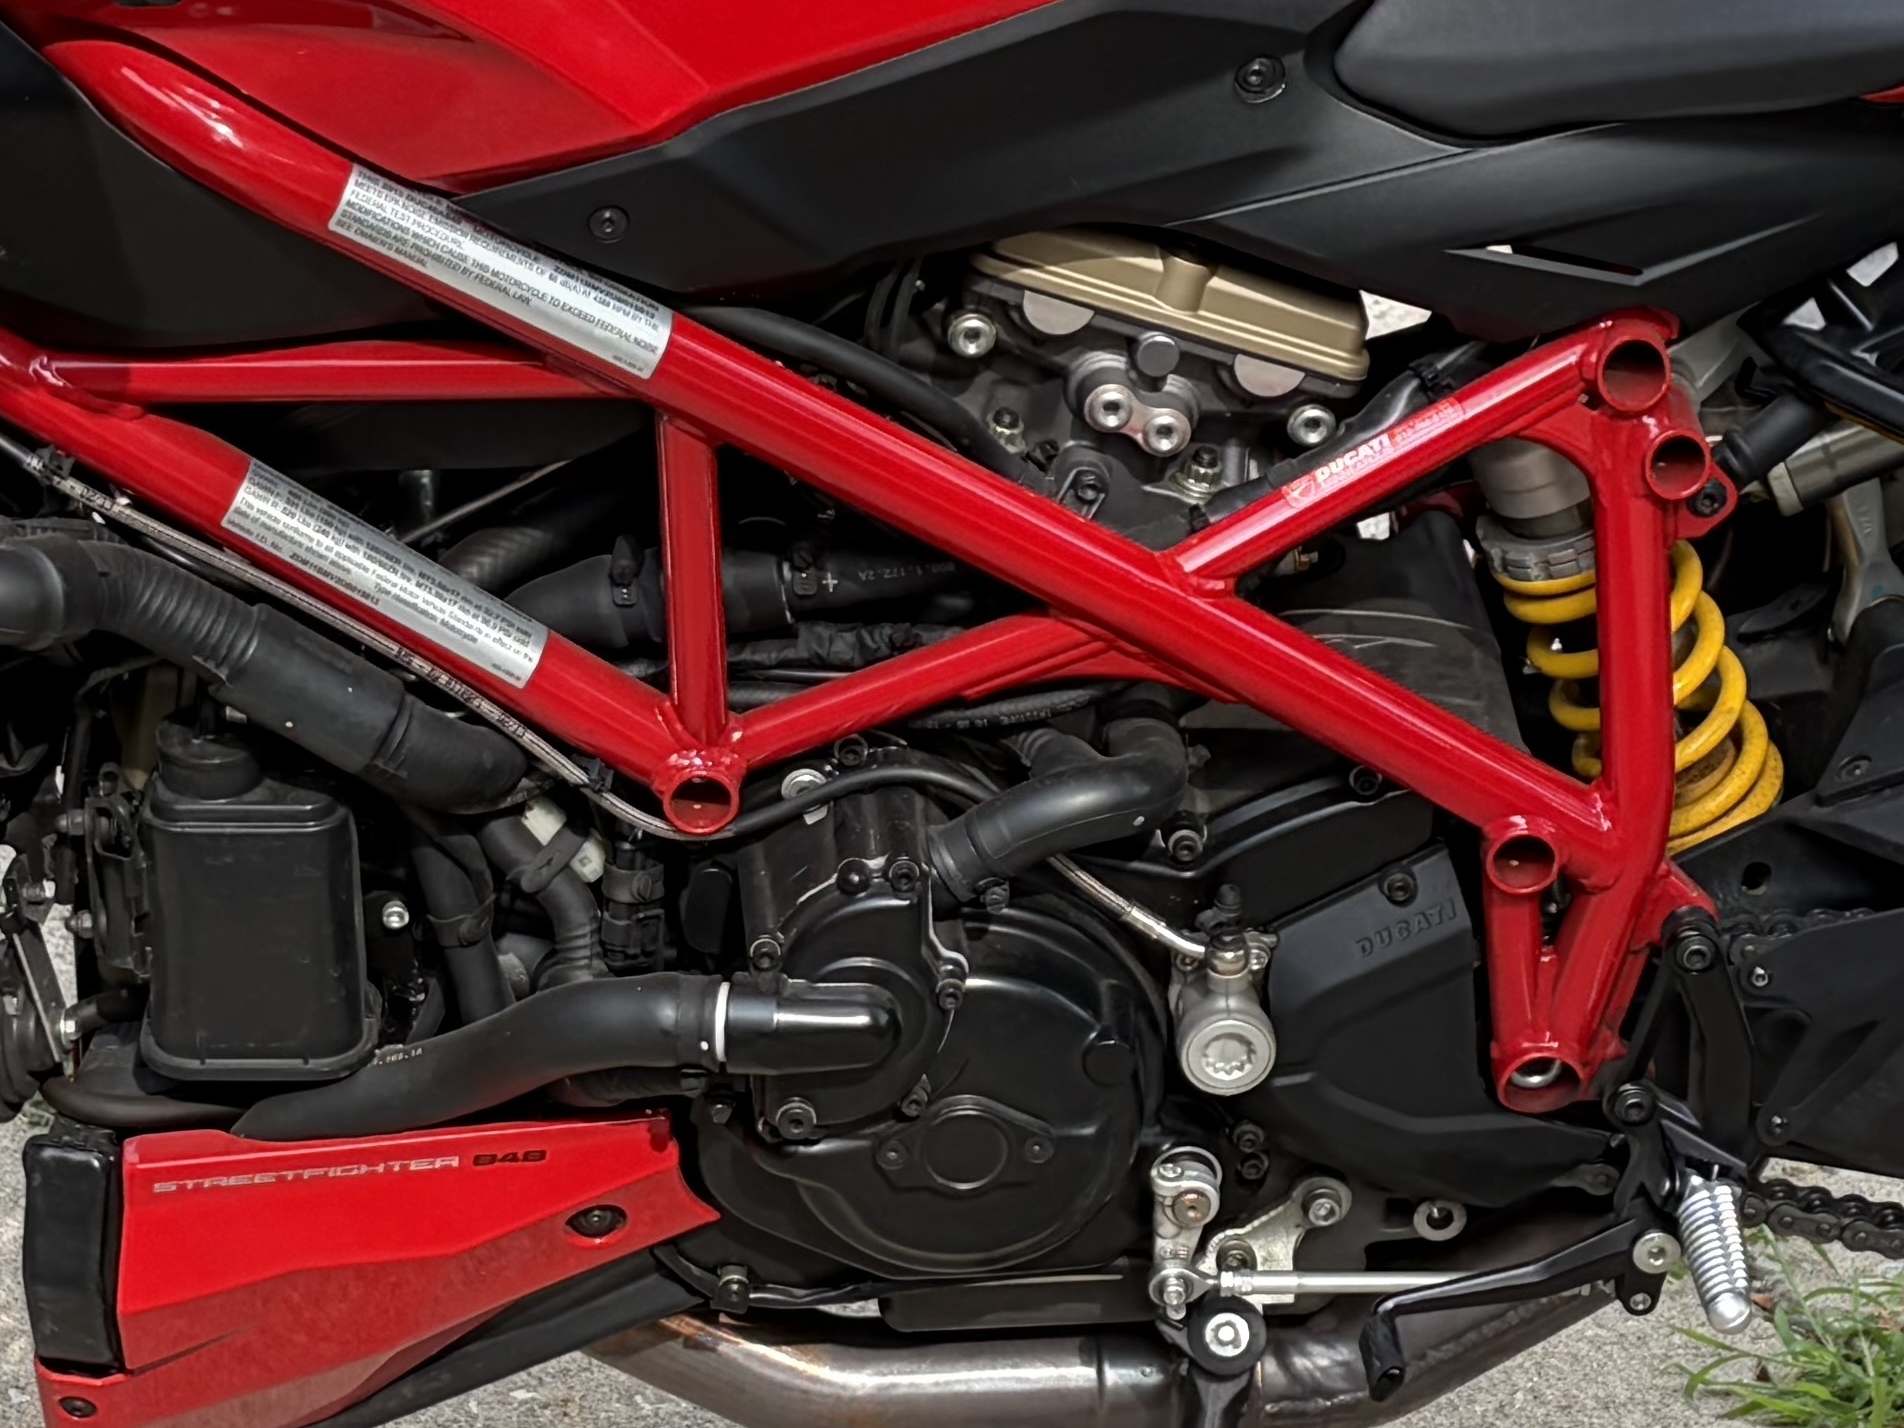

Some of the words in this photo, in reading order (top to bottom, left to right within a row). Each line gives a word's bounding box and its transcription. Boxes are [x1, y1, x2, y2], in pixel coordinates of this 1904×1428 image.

[388, 206, 412, 224] TEST
[344, 198, 412, 236] MODIFICATIONS
[410, 229, 441, 251] WHICH
[438, 243, 471, 265] CAUSE
[468, 257, 491, 275] THIS
[488, 267, 550, 303] MOTORCYCLE
[546, 295, 561, 309] TO
[559, 301, 597, 326] EXCEED
[593, 317, 634, 343] FEDERAL
[389, 232, 410, 248] ARE
[408, 240, 462, 273] PROHIBITED
[473, 271, 512, 297] FEDERAL
[1315, 433, 1393, 483] DUCATI
[371, 580, 393, 598] Type
[1355, 898, 1457, 958] DUCATI
[152, 1155, 460, 1193] STREETFIGHTER
[472, 1148, 548, 1168] 848
